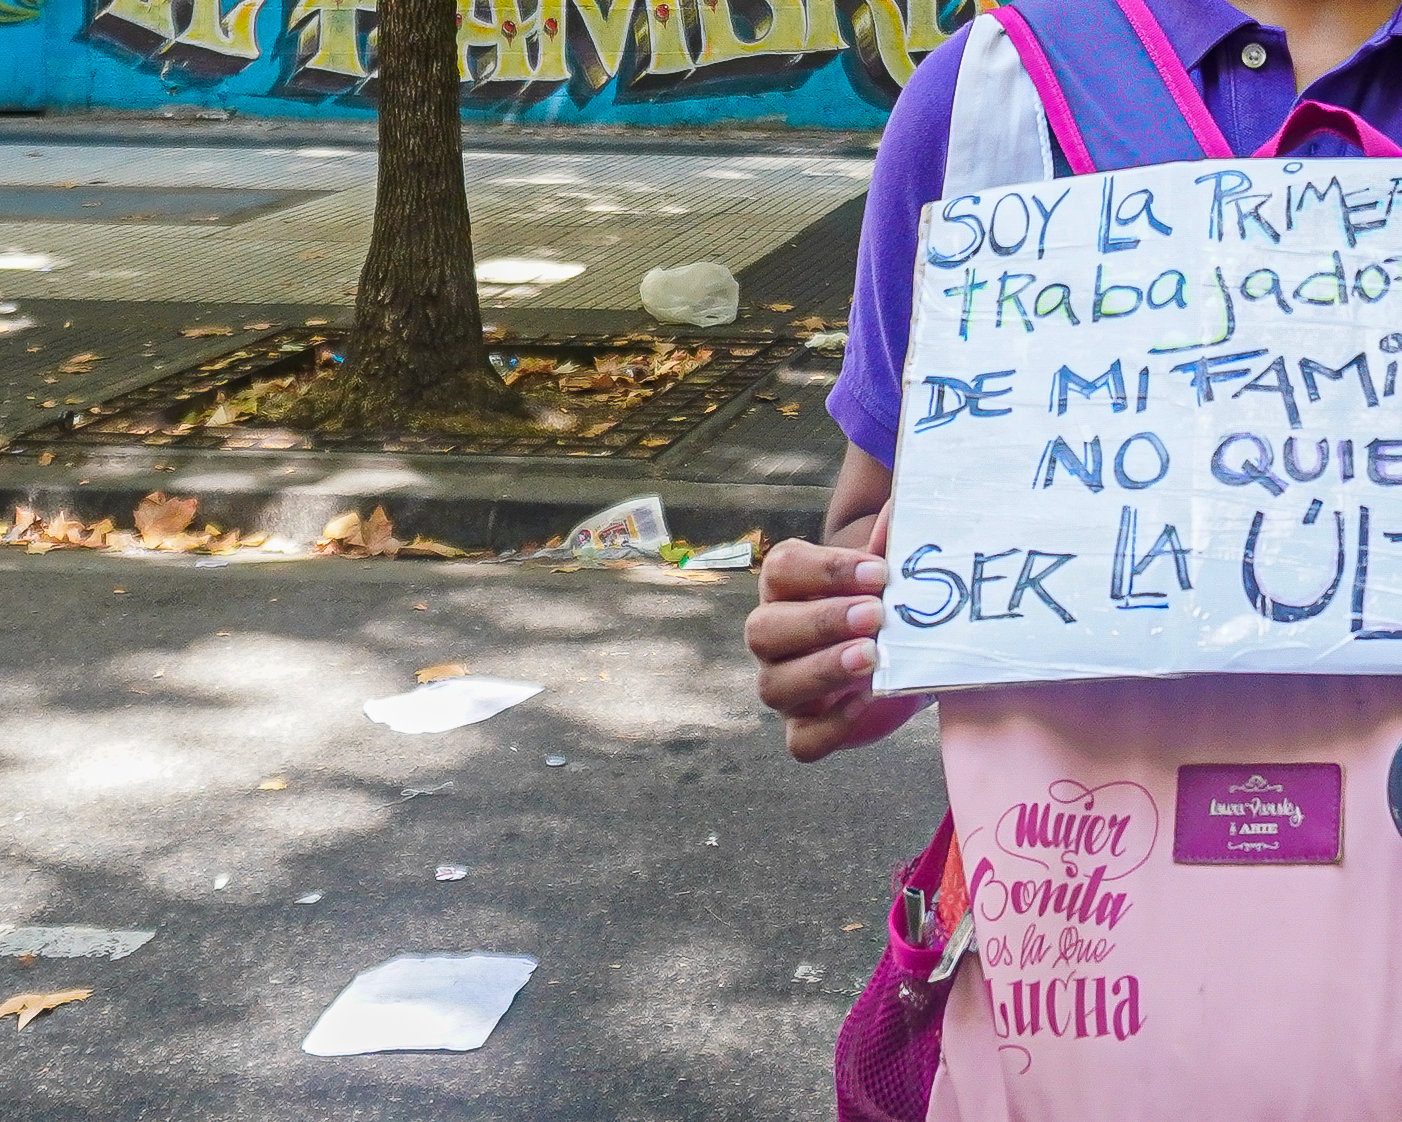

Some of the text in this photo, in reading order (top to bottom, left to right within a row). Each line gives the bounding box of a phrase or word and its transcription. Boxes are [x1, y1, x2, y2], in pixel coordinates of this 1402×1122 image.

[927, 186, 1071, 269] SOY
[914, 368, 1013, 434] DE
[1048, 357, 1150, 417] MI
[1031, 429, 1171, 494] NO
[893, 542, 1077, 629] SER
[1108, 505, 1193, 612] LA
[985, 936, 1013, 968] es
[1019, 922, 1053, 970] la
